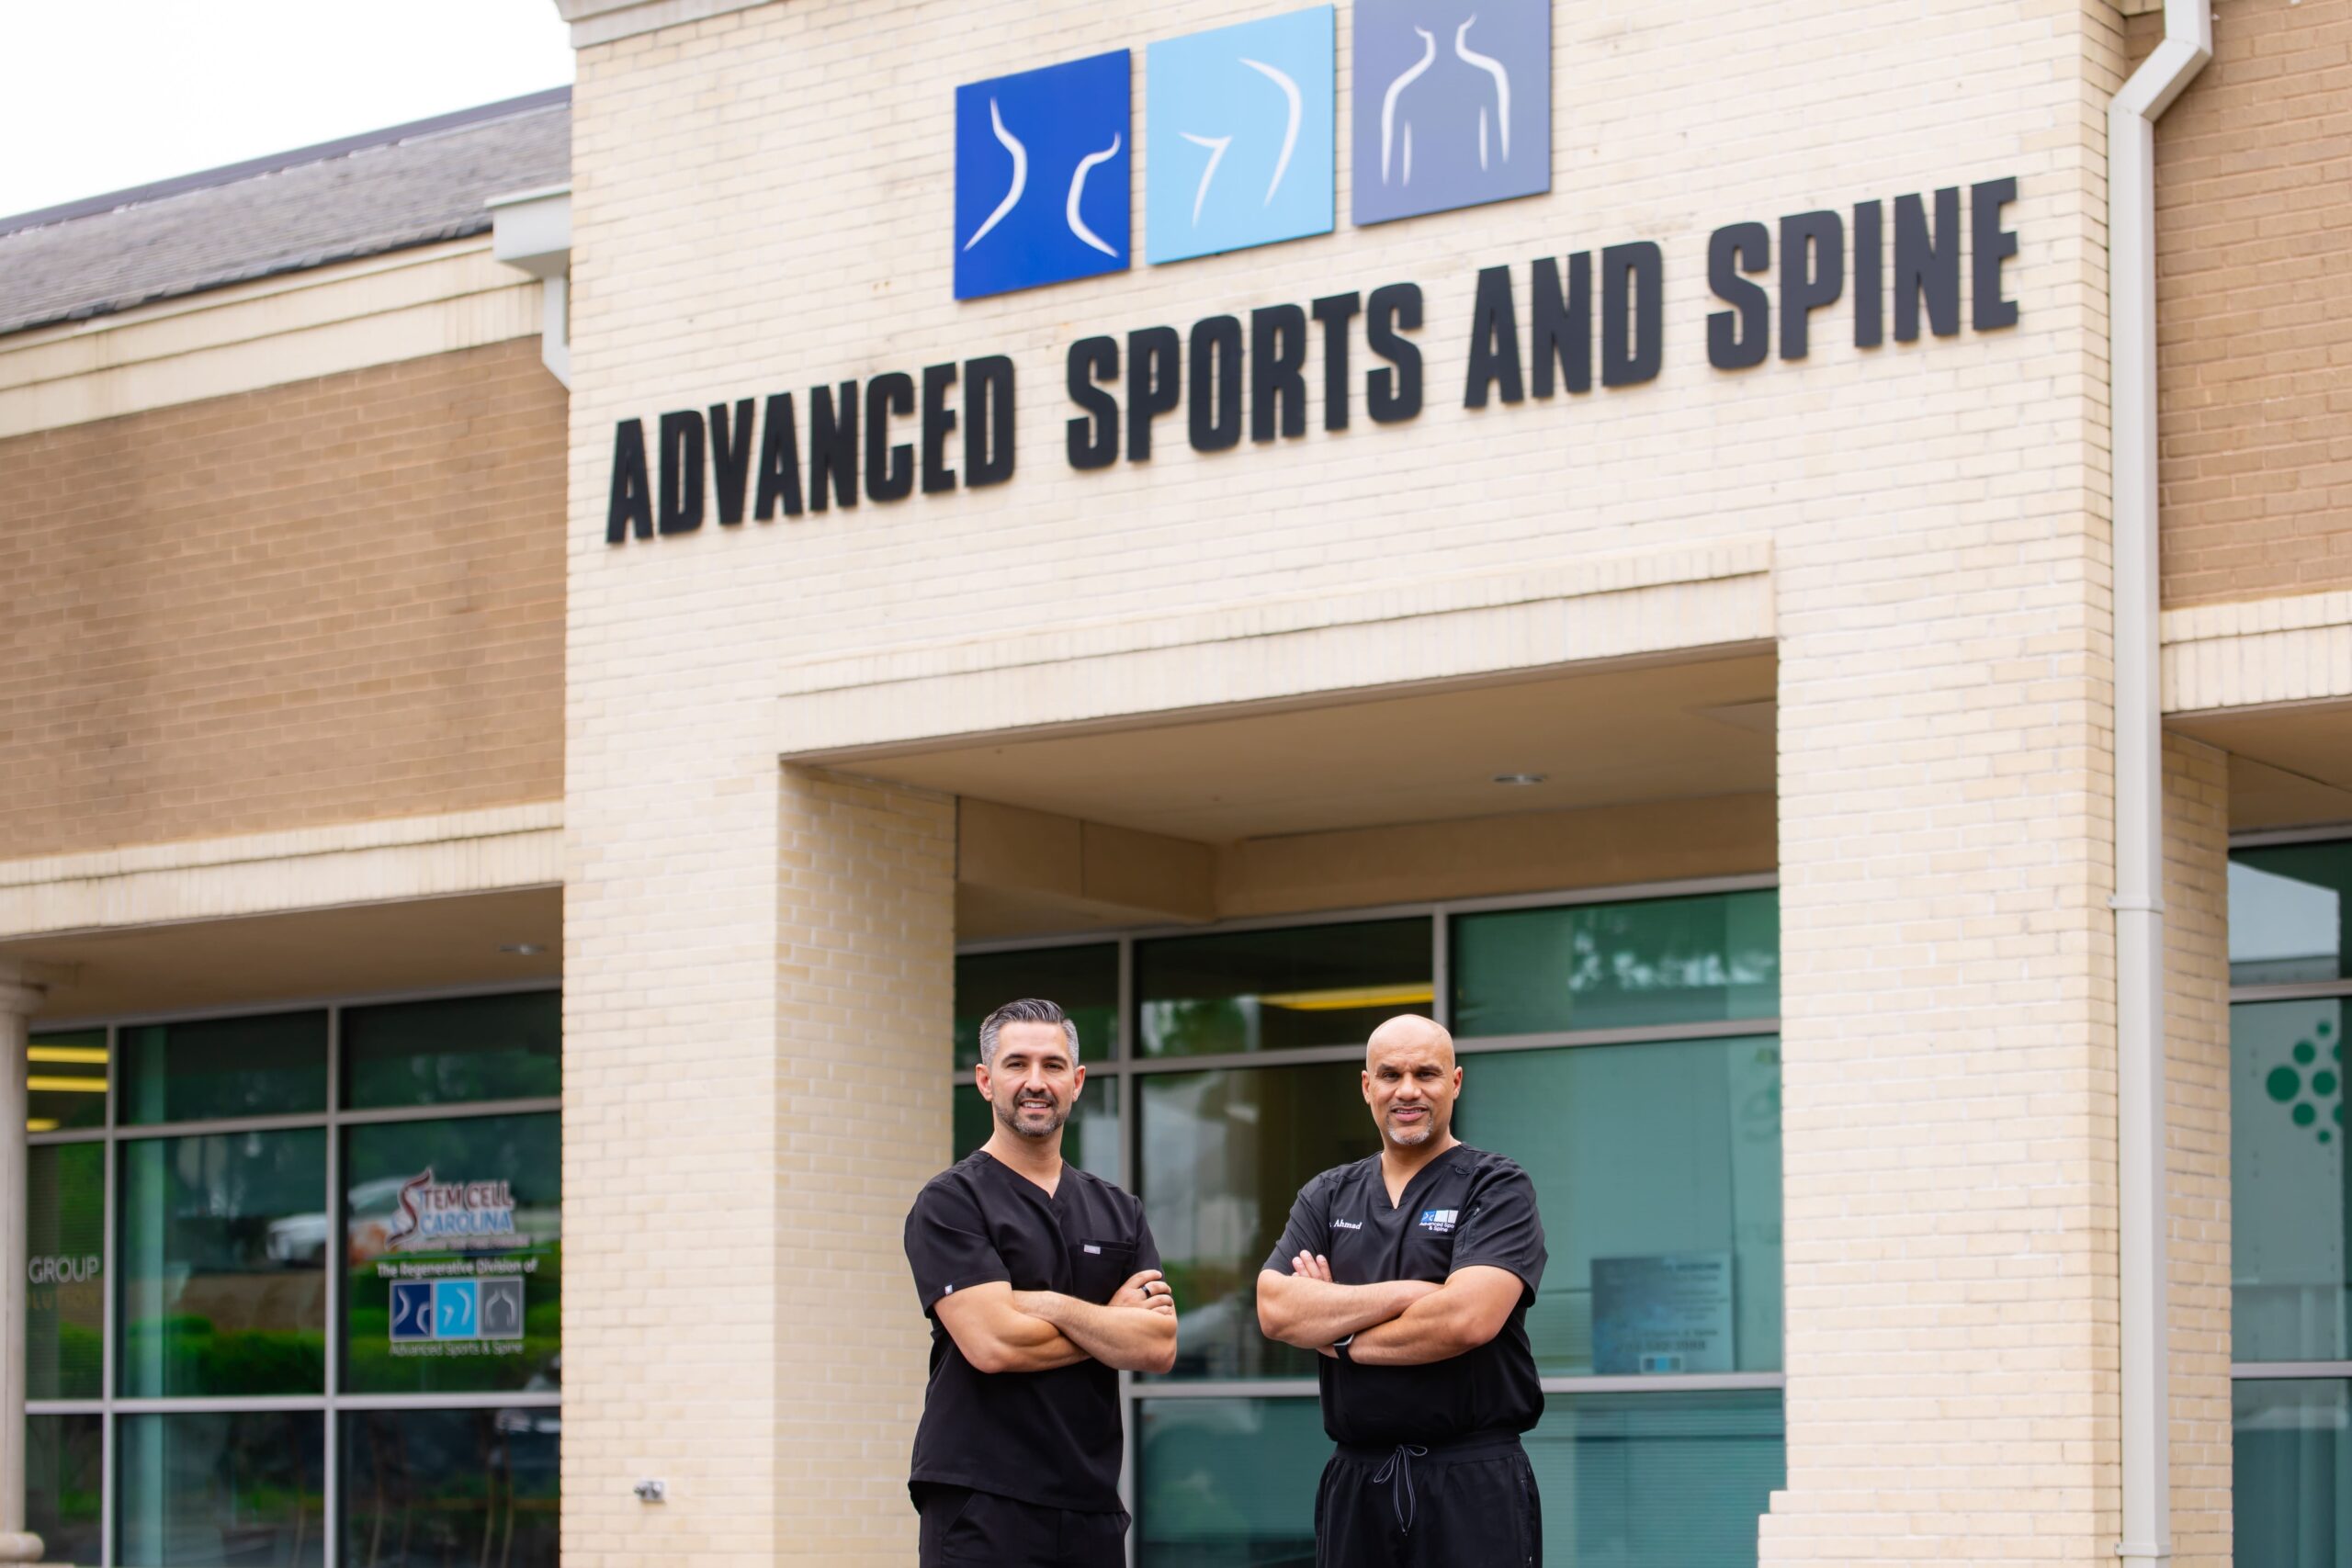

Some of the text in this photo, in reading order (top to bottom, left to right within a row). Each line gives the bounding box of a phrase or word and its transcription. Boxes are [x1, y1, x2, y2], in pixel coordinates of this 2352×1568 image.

[605, 175, 2019, 544] ADVANCED SPORTS AND SPINE
[386, 1168, 516, 1247] STEM CELL
[420, 1210, 514, 1235] CAROLINA
[1333, 1218, 1363, 1230] Ahmad
[28, 1255, 100, 1284] GROUP
[377, 1258, 538, 1278] The Regenerative Division of
[389, 1340, 524, 1358] Advanced Sports & Spine
